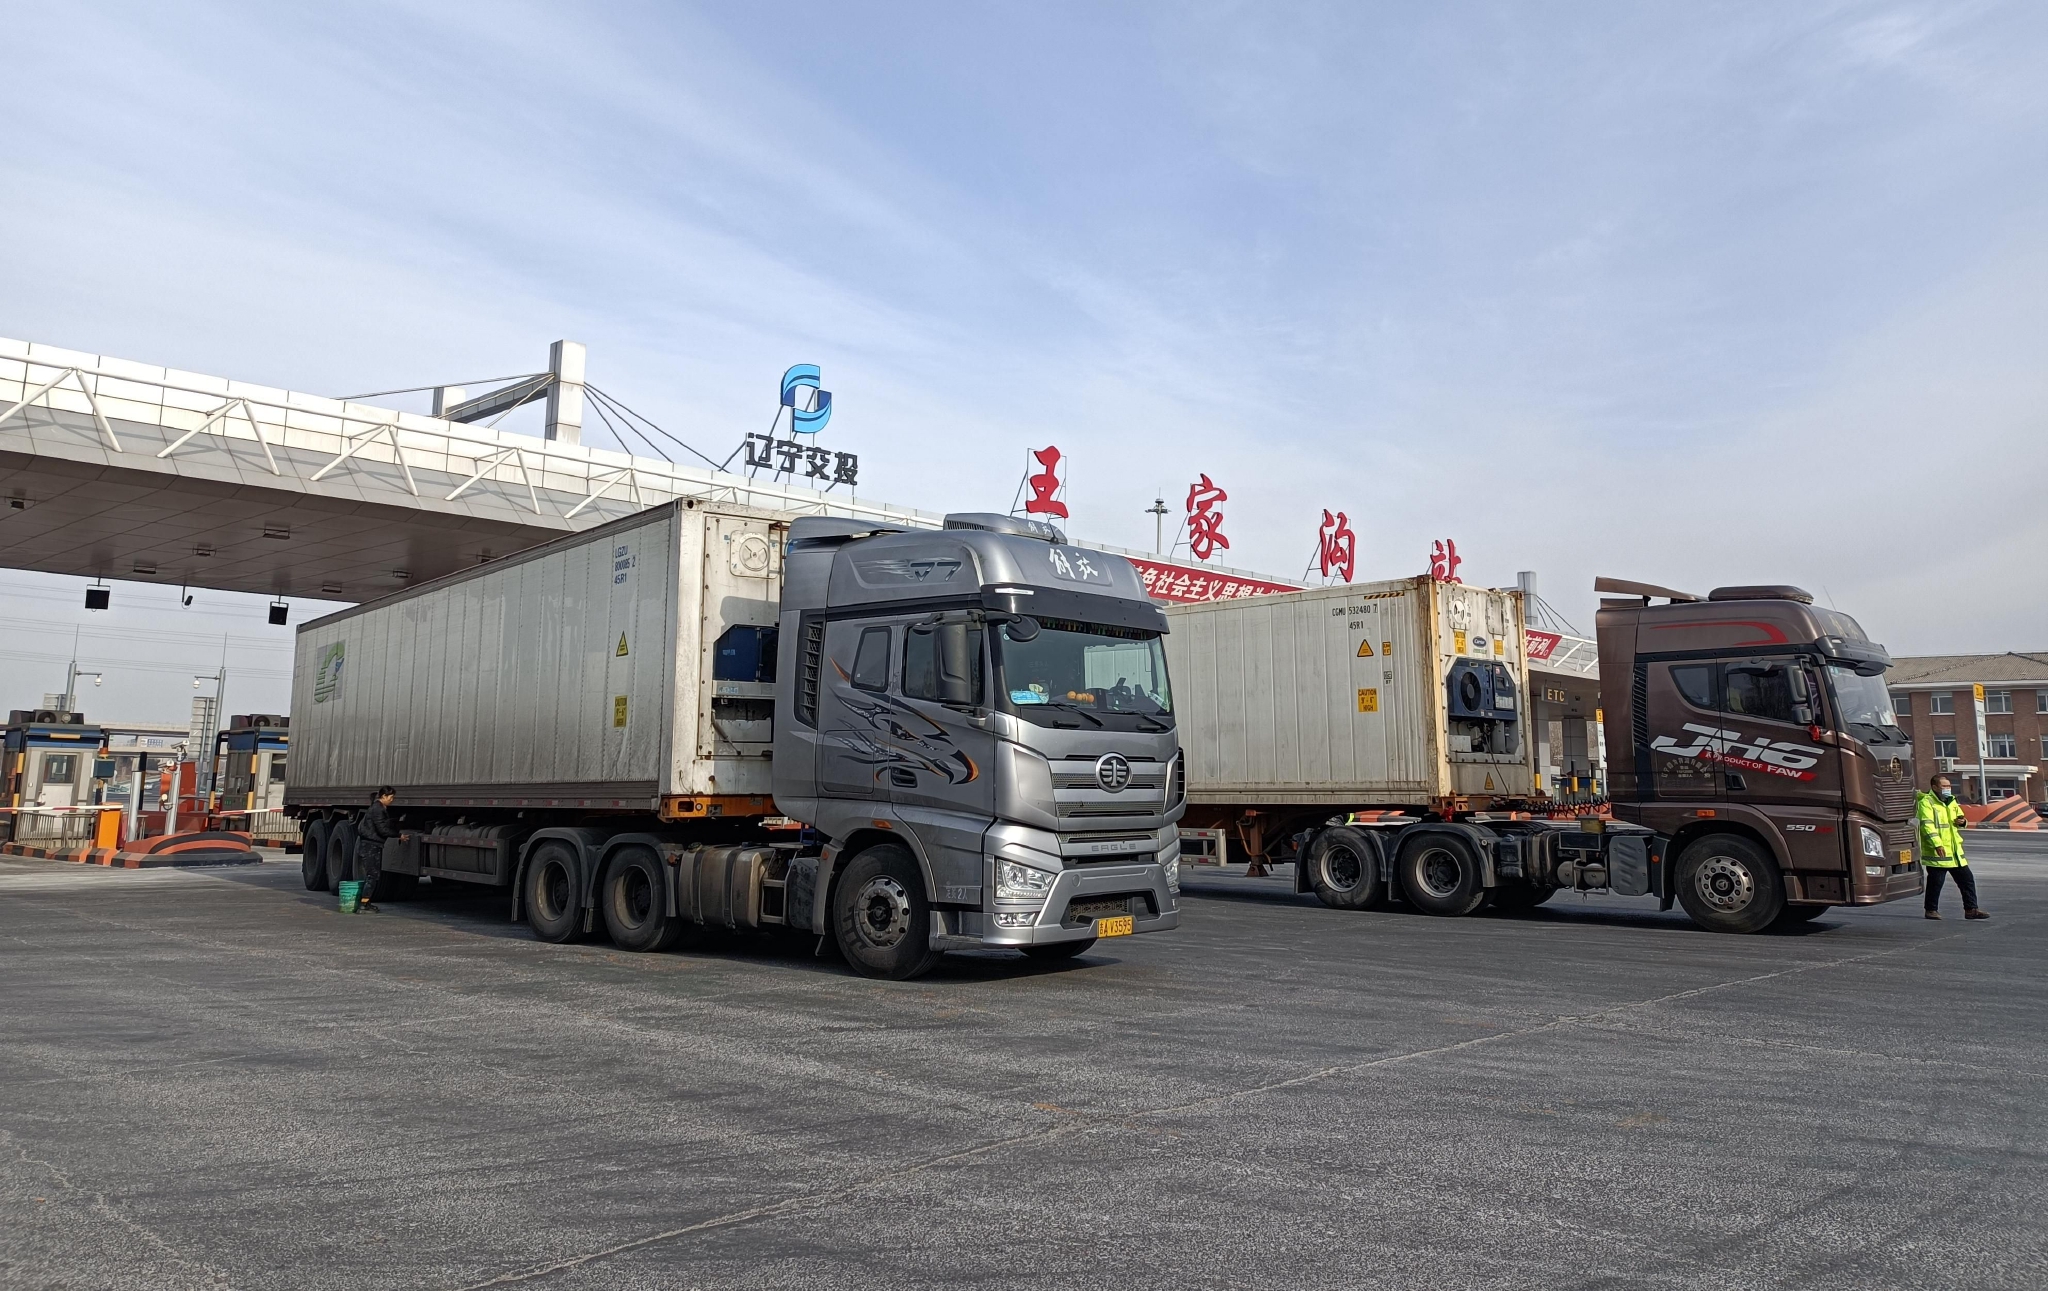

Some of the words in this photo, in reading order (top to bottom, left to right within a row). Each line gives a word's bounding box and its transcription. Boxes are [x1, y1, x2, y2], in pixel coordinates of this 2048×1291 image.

[746, 431, 858, 486] 辽宁交投
[631, 554, 637, 568] 2
[614, 572, 628, 585] 45R1
[1133, 564, 1285, 602] 色社会主义思想
[1331, 607, 1347, 617] CGMU
[1348, 604, 1371, 615] 532480
[1372, 603, 1379, 614] 7
[1349, 620, 1364, 630] 45R1
[1546, 688, 1566, 702] ETC
[1752, 761, 1763, 769] OF
[1766, 764, 1804, 778] FAW
[1785, 824, 1817, 832] 550
[1091, 843, 1137, 852] EAGLE
